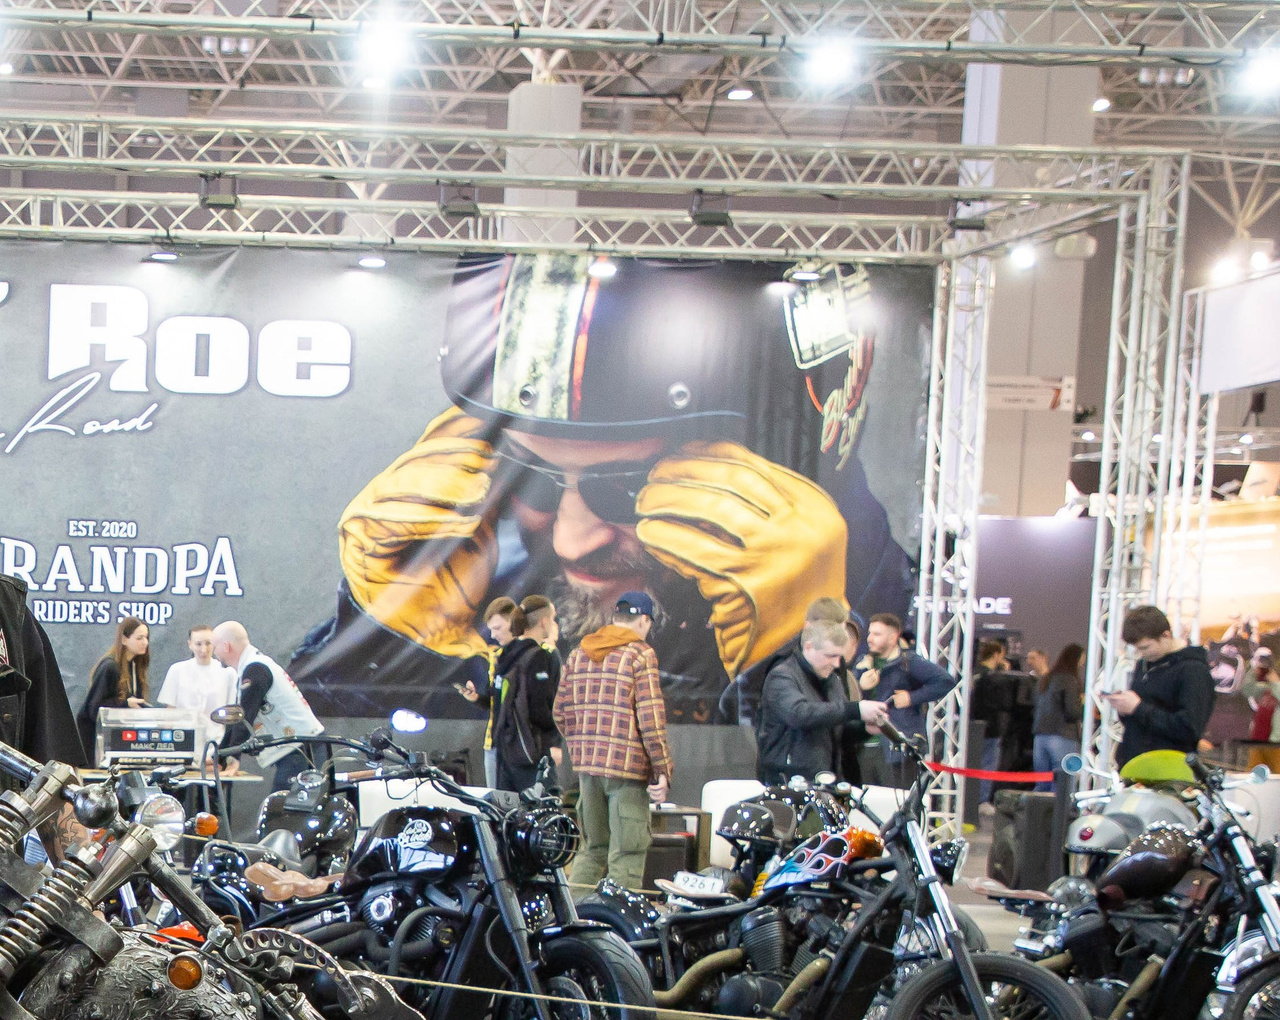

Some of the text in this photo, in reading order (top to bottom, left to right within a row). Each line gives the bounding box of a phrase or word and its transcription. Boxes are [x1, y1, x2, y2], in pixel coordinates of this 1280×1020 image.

[48, 283, 352, 397] Roe
[4, 371, 158, 453] Road
[68, 520, 137, 539] EST. 2020
[33, 600, 173, 625] RIDER'S SHOP
[130, 742, 156, 751] МАКС
